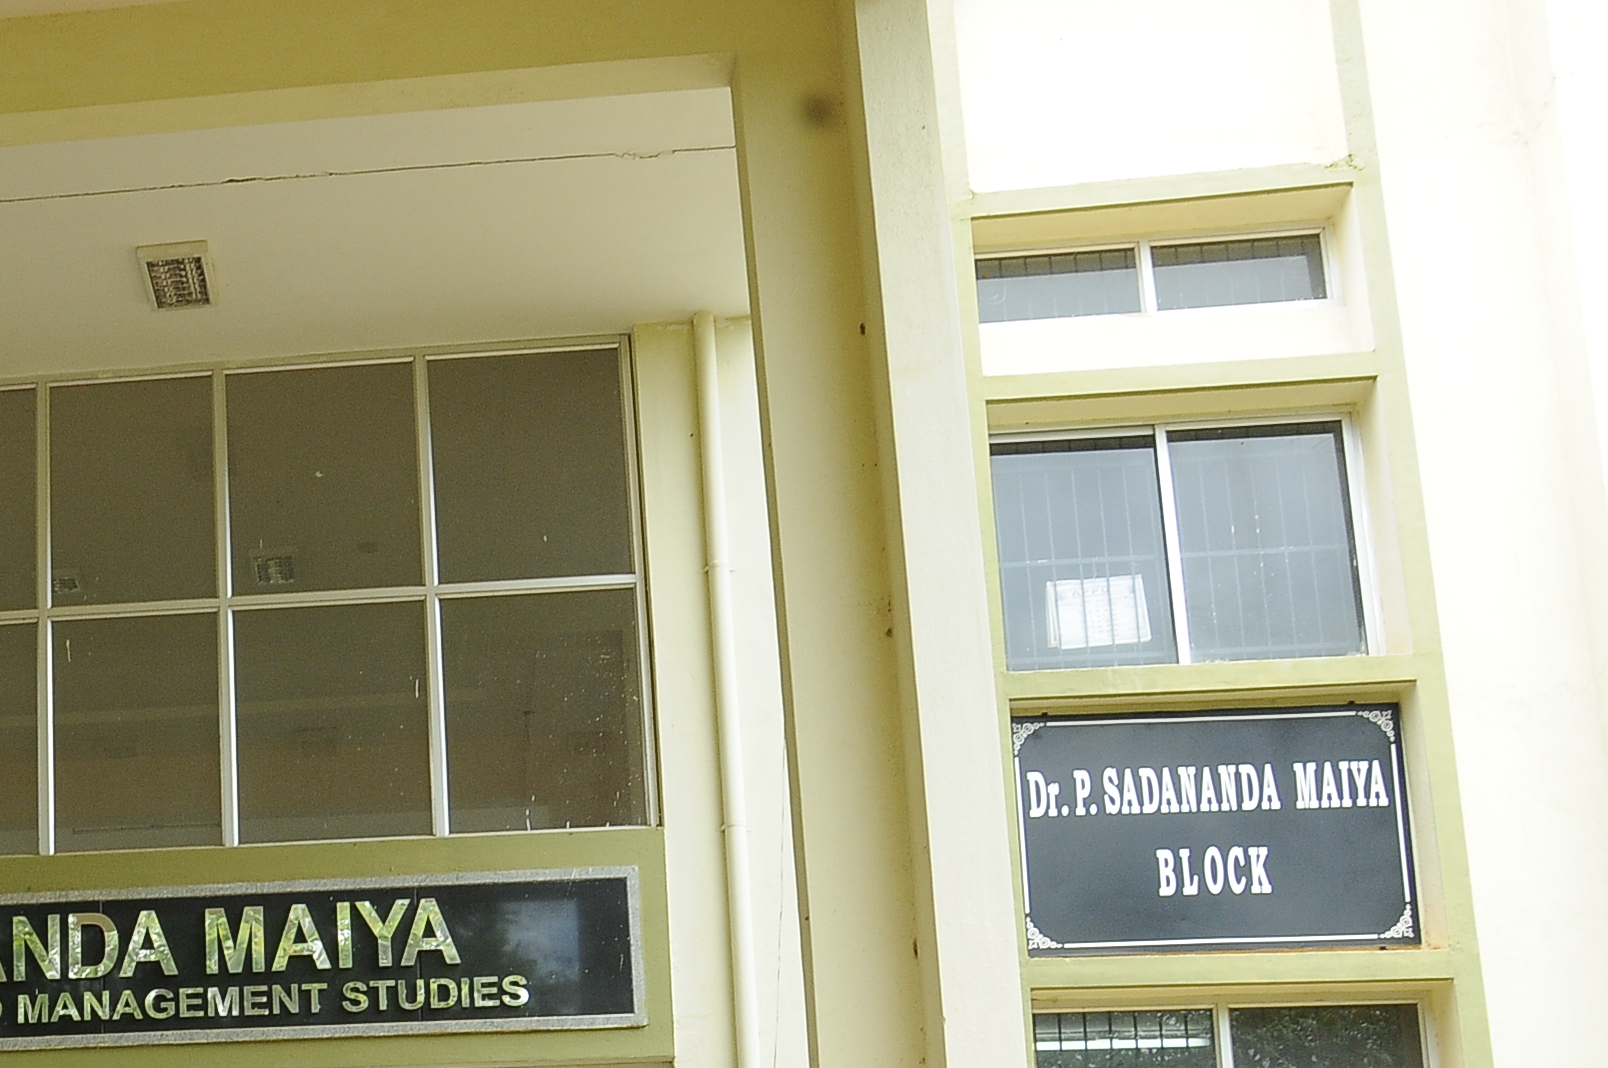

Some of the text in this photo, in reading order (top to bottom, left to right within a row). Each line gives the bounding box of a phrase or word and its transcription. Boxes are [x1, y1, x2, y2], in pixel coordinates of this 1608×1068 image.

[1026, 759, 1390, 818] Dr. P. SADANANDA MAIYA
[1156, 846, 1273, 897] BLOCK
[204, 897, 462, 976] MAIYA
[16, 983, 328, 1025] MANAGEMENT
[341, 974, 530, 1014] STUDIES
